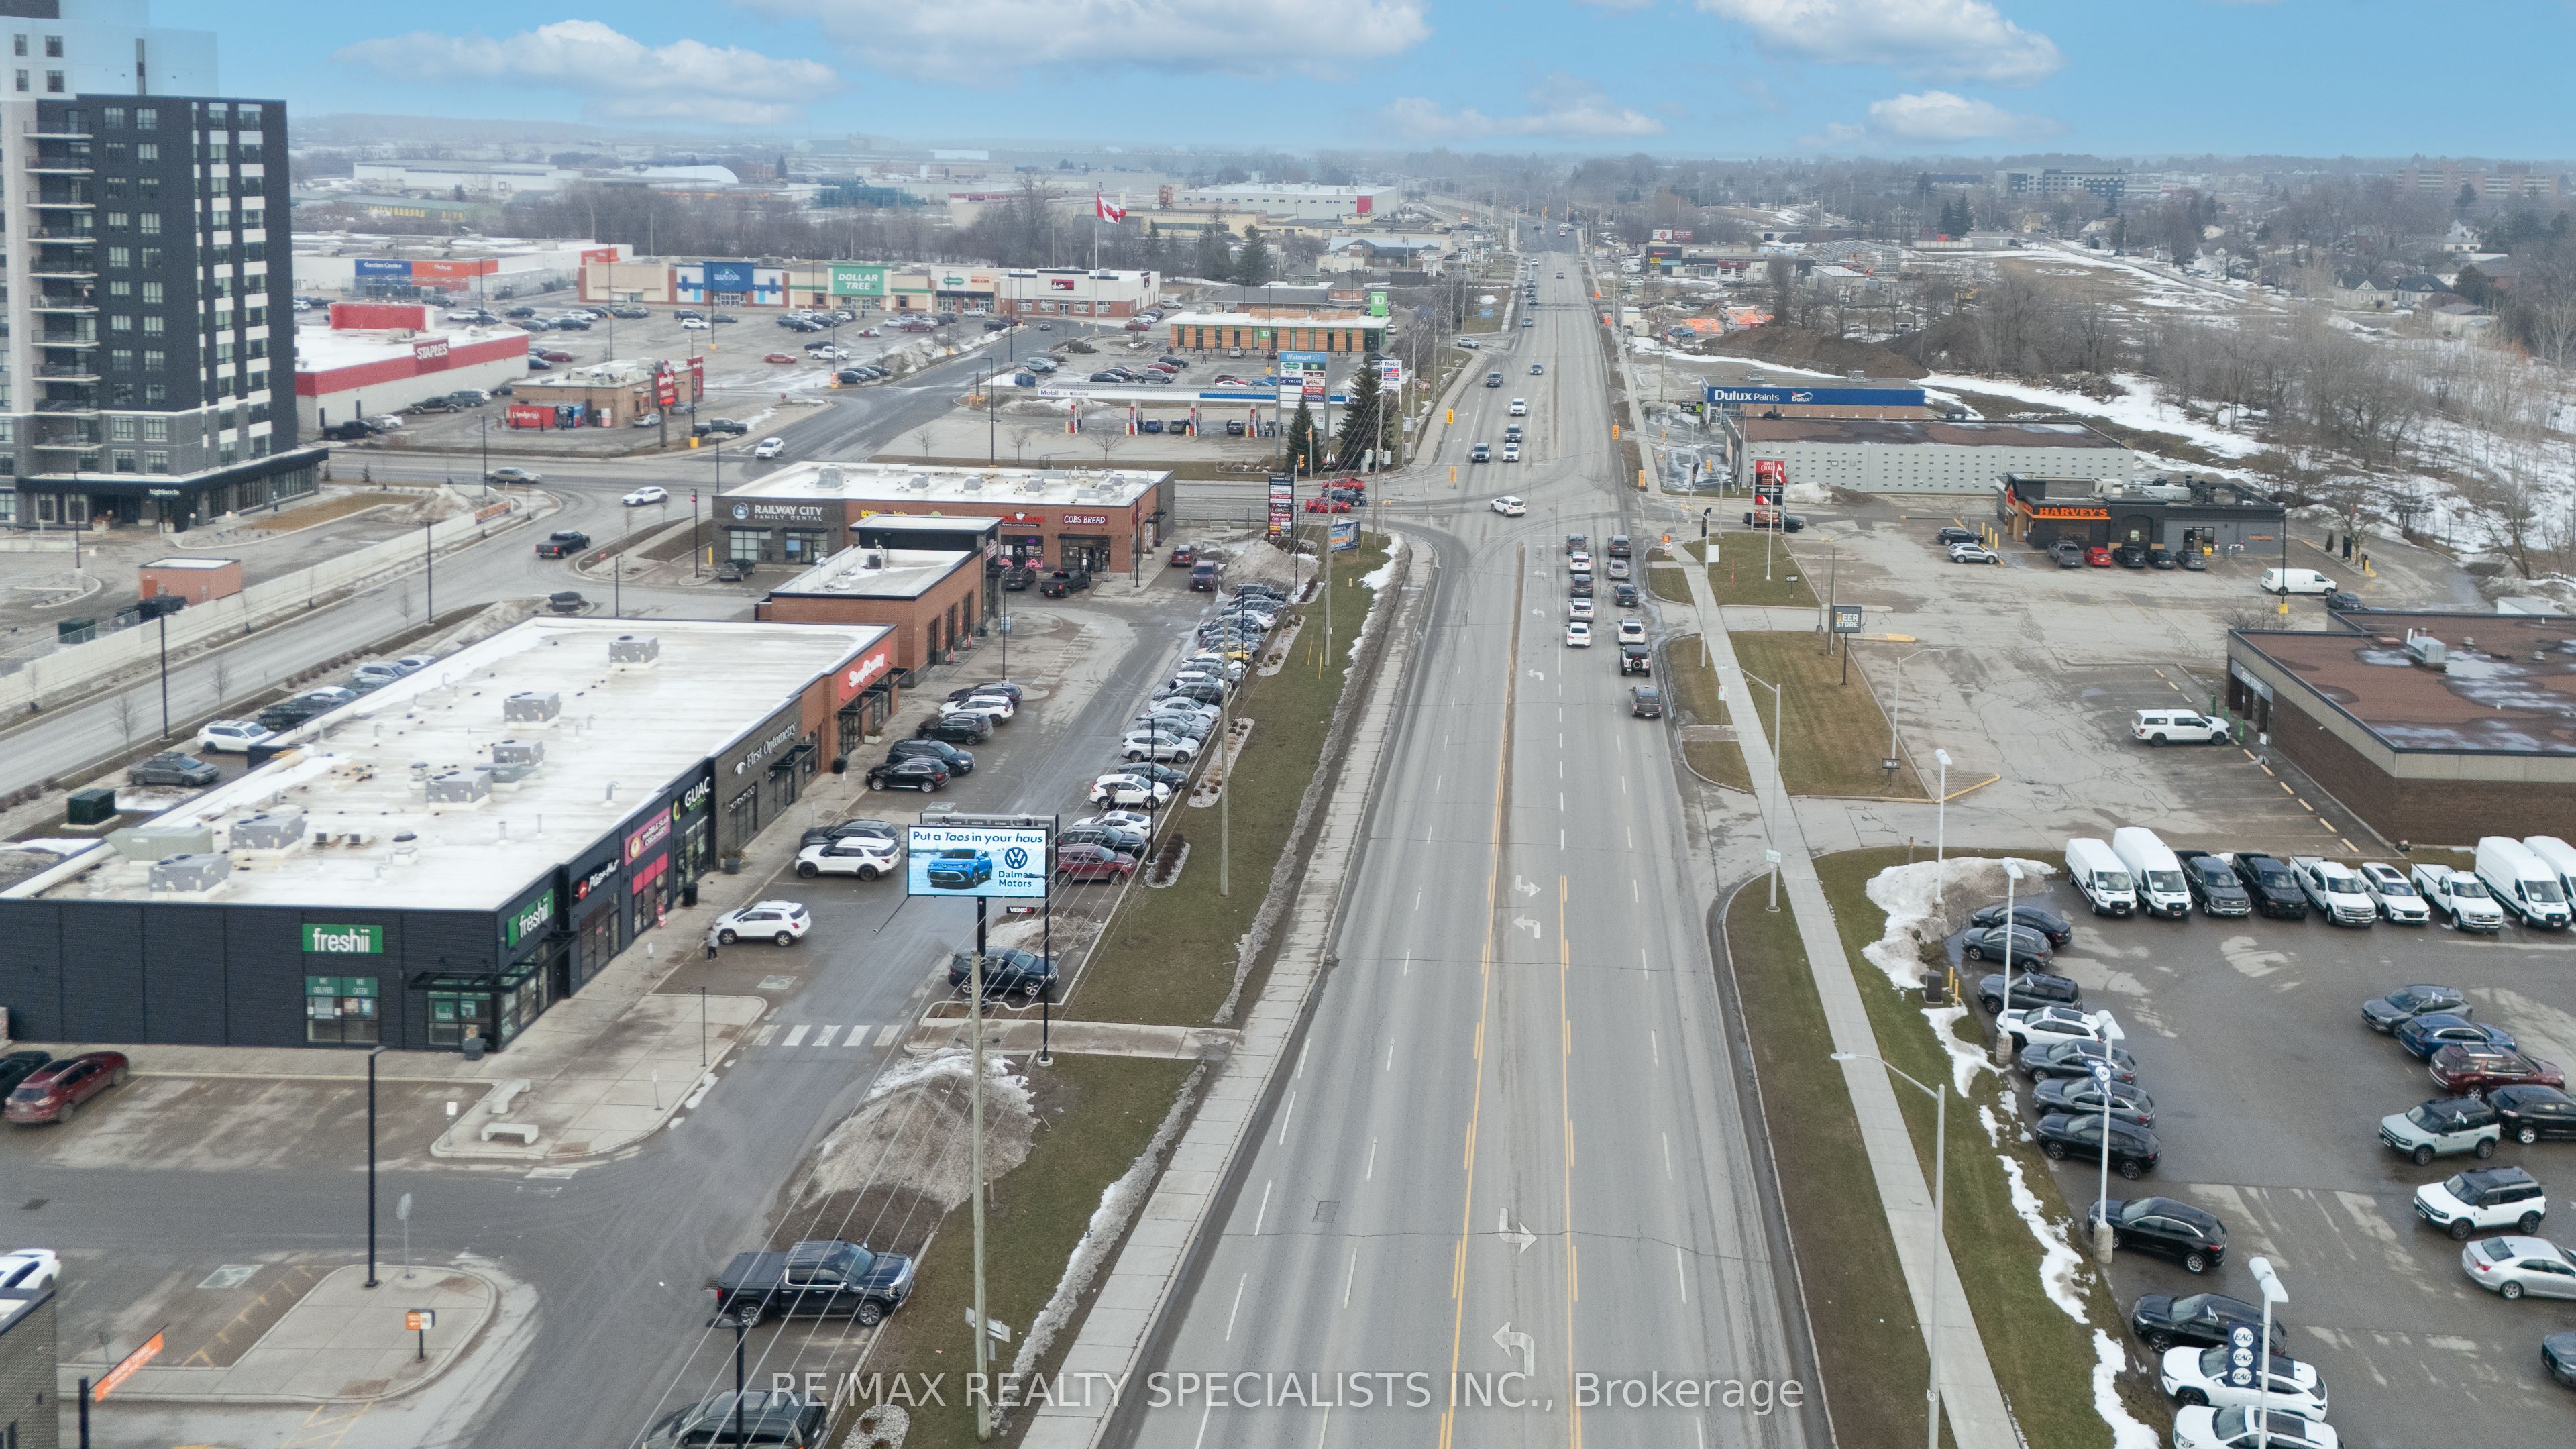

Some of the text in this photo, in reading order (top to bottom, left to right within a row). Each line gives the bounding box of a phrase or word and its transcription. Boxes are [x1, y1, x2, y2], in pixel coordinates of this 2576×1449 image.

[838, 273, 879, 282] DOLLAR
[846, 282, 871, 290] TREE
[1373, 296, 1384, 305] TD
[417, 343, 447, 360] STAPLES
[1715, 390, 1780, 401] Dulux Paints
[754, 504, 822, 516] RAILWAY CITY
[2039, 507, 2108, 517] HARVEY'S
[1064, 515, 1106, 524] COBS BREAD
[1836, 613, 1859, 622] BEER
[747, 722, 796, 768] First Optometry
[684, 777, 710, 807] GUAC
[913, 830, 931, 841] Put
[945, 832, 970, 841] Taos
[972, 833, 981, 842] in
[985, 835, 1012, 844] your
[1016, 833, 1042, 843] haus
[588, 859, 620, 892] Pizza Hut
[519, 896, 549, 938] freshii
[313, 928, 370, 951] freshii
[2235, 1333, 2253, 1341] EAG
